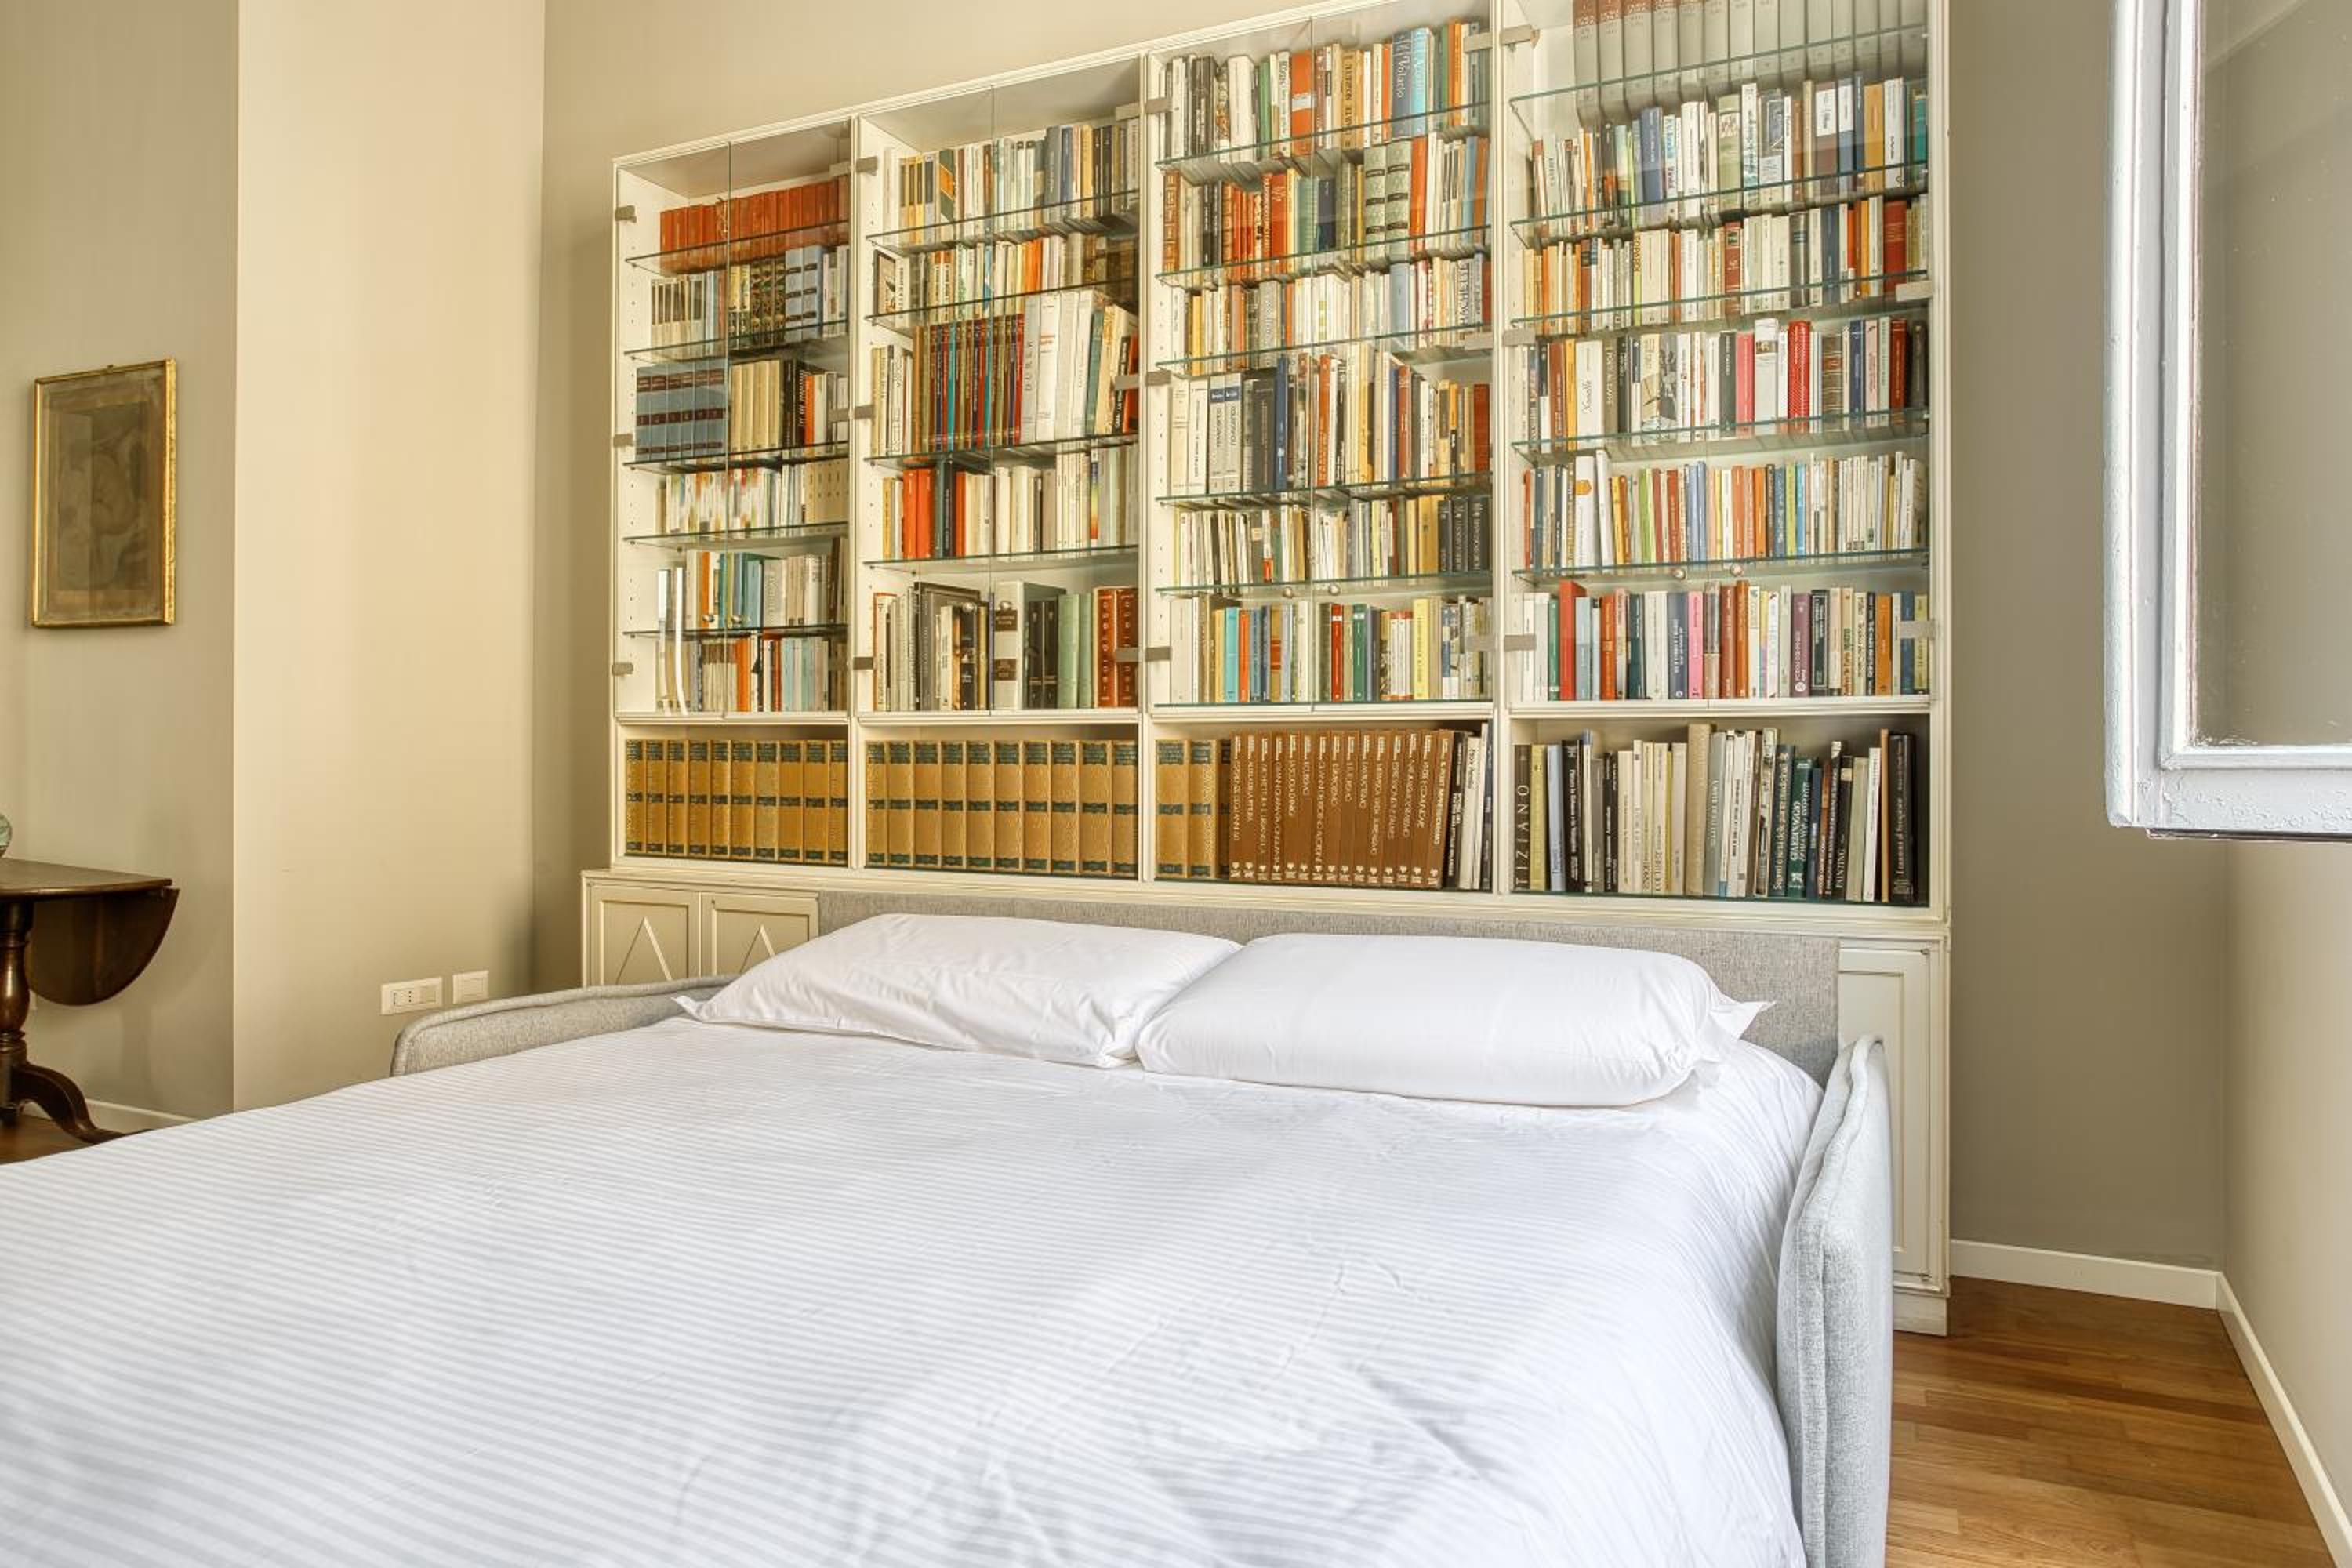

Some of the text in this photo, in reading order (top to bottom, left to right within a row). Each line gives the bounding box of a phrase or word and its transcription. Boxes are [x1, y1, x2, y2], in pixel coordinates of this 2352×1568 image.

[1516, 785, 1529, 885] TIZIANO
[1790, 800, 1801, 862] GIARDINAGGIO
[1836, 849, 1845, 889] PAINTING
